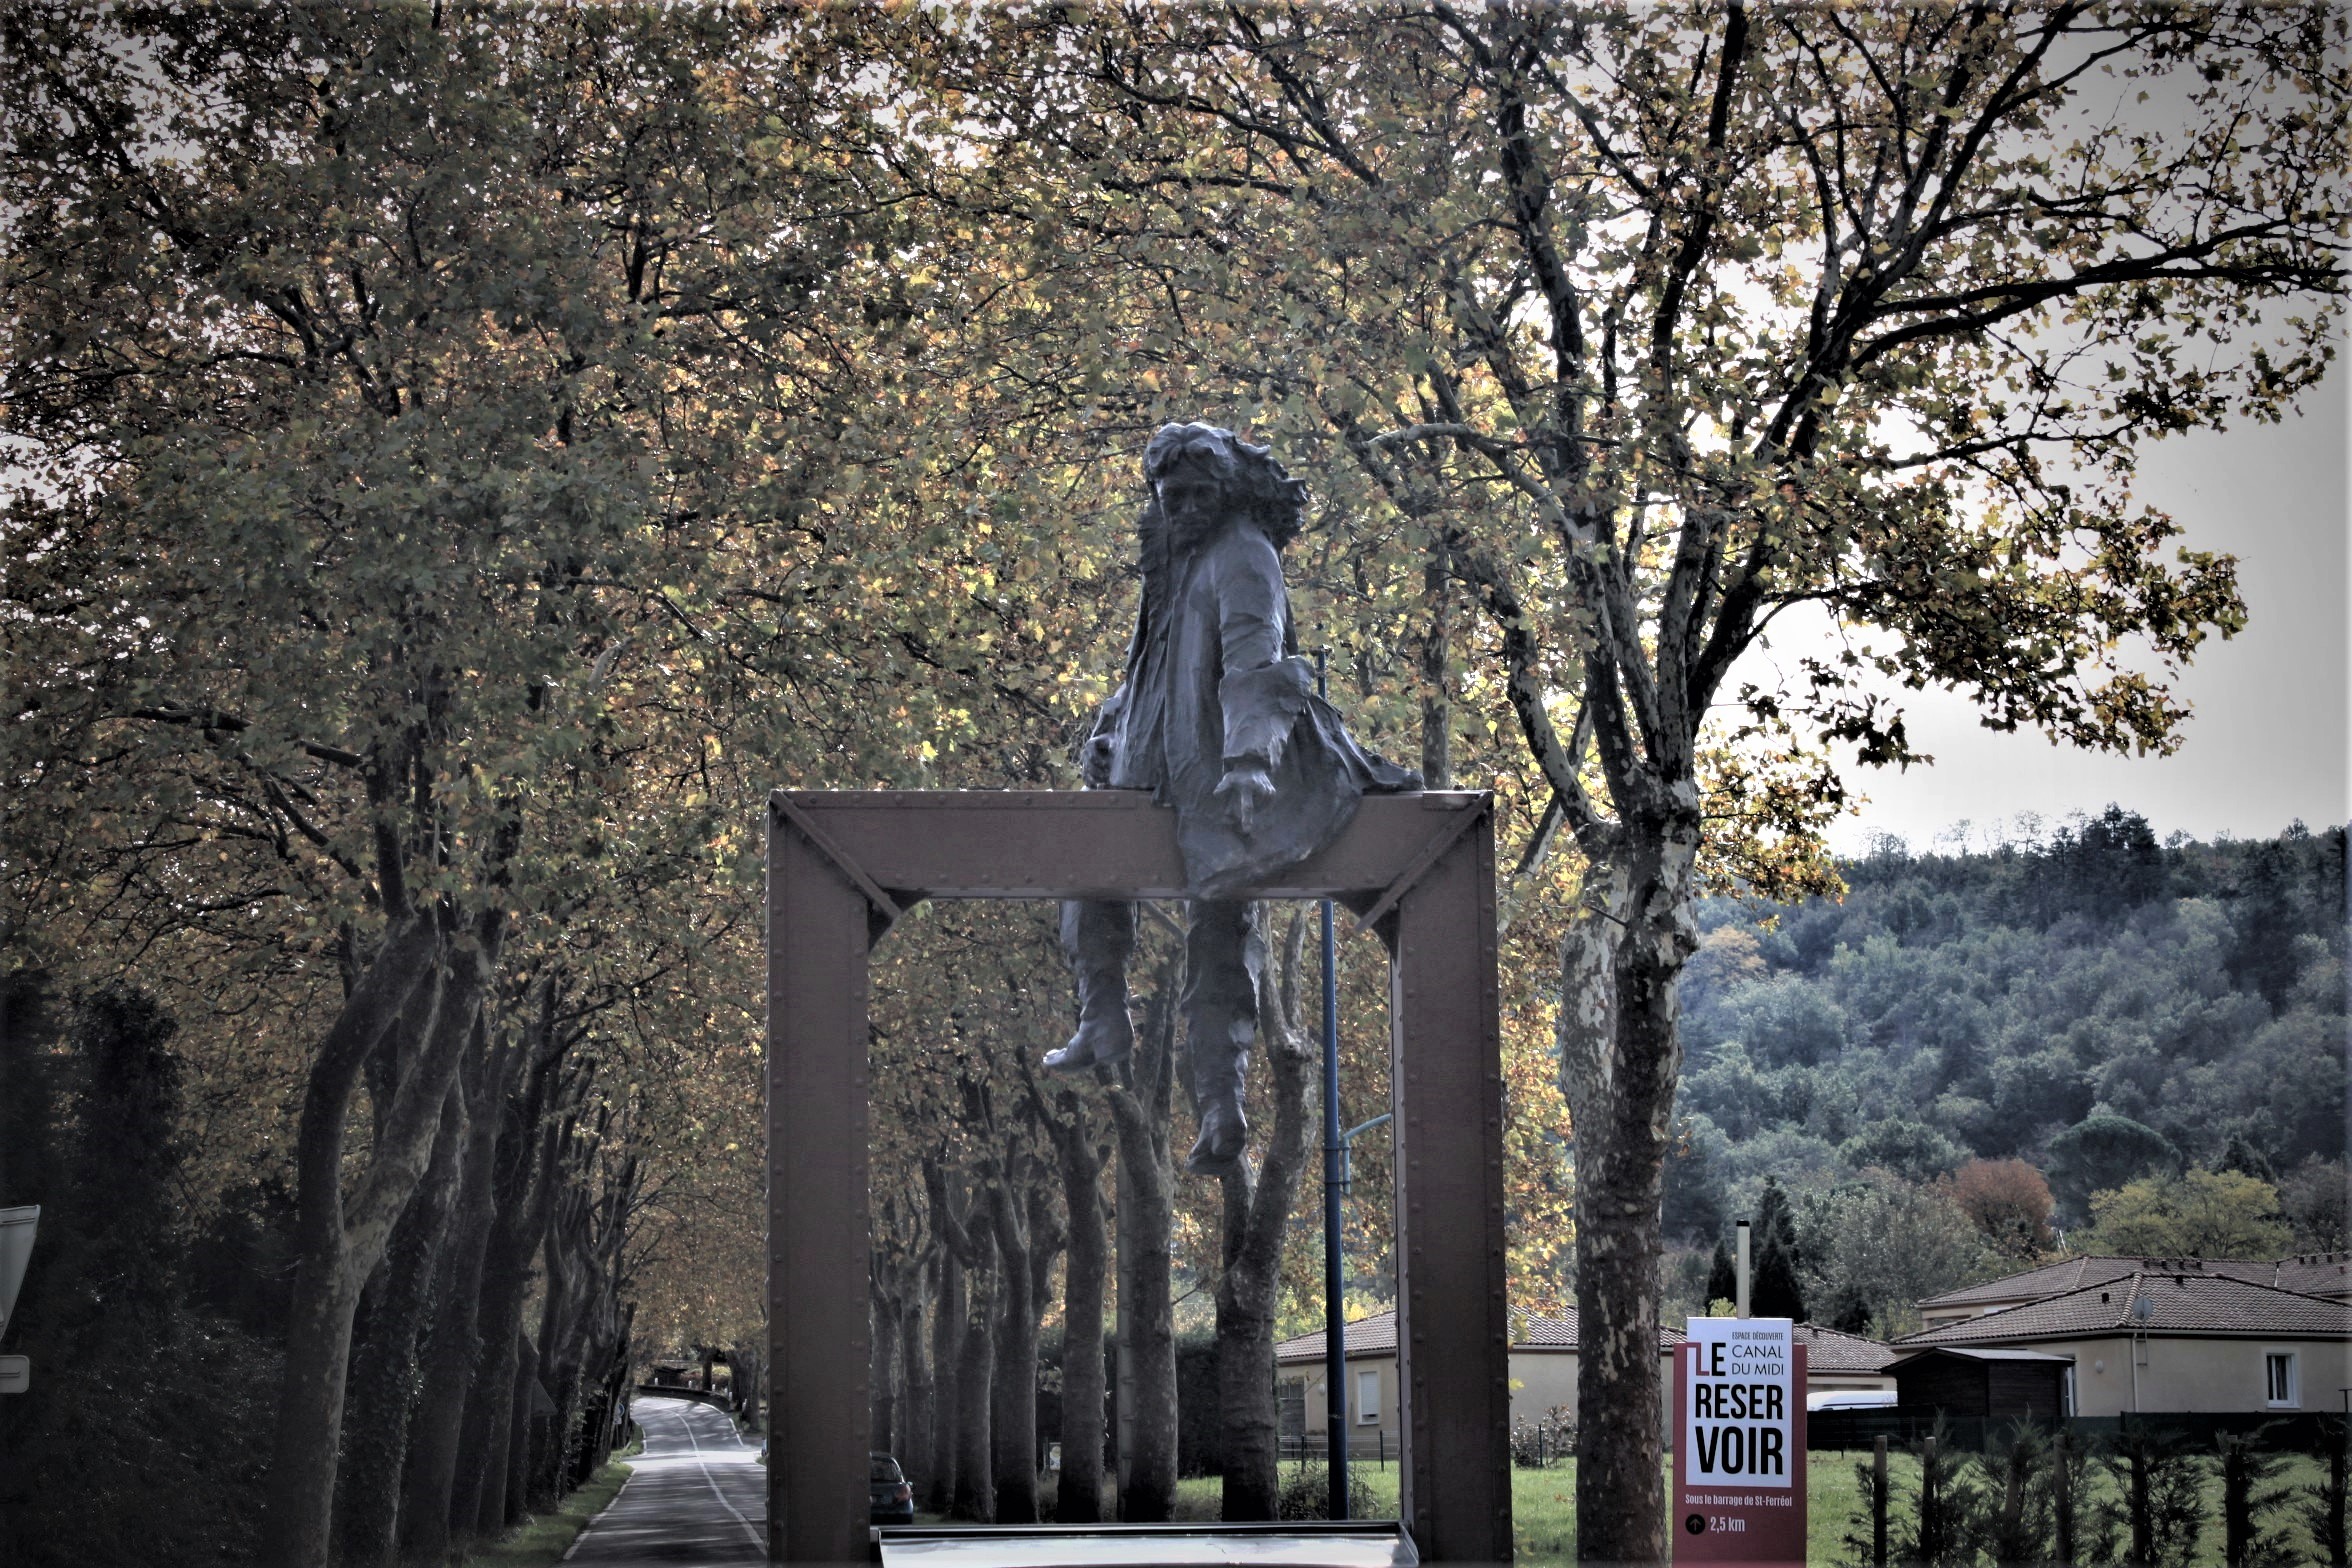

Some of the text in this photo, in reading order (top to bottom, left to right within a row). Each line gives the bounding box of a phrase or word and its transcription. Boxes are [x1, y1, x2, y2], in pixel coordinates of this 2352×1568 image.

[1732, 1331, 1784, 1340] ESPACE DÉCOUVERTE
[1695, 1342, 1726, 1376] LE
[1731, 1345, 1784, 1358] CANAL
[1731, 1363, 1784, 1376] DU MIDI
[1695, 1383, 1783, 1420] RESER
[1695, 1426, 1783, 1475] VOIR
[1685, 1494, 1792, 1507] Sous le barrage de St-Ferréol
[1710, 1516, 1746, 1534] 2,5 km
